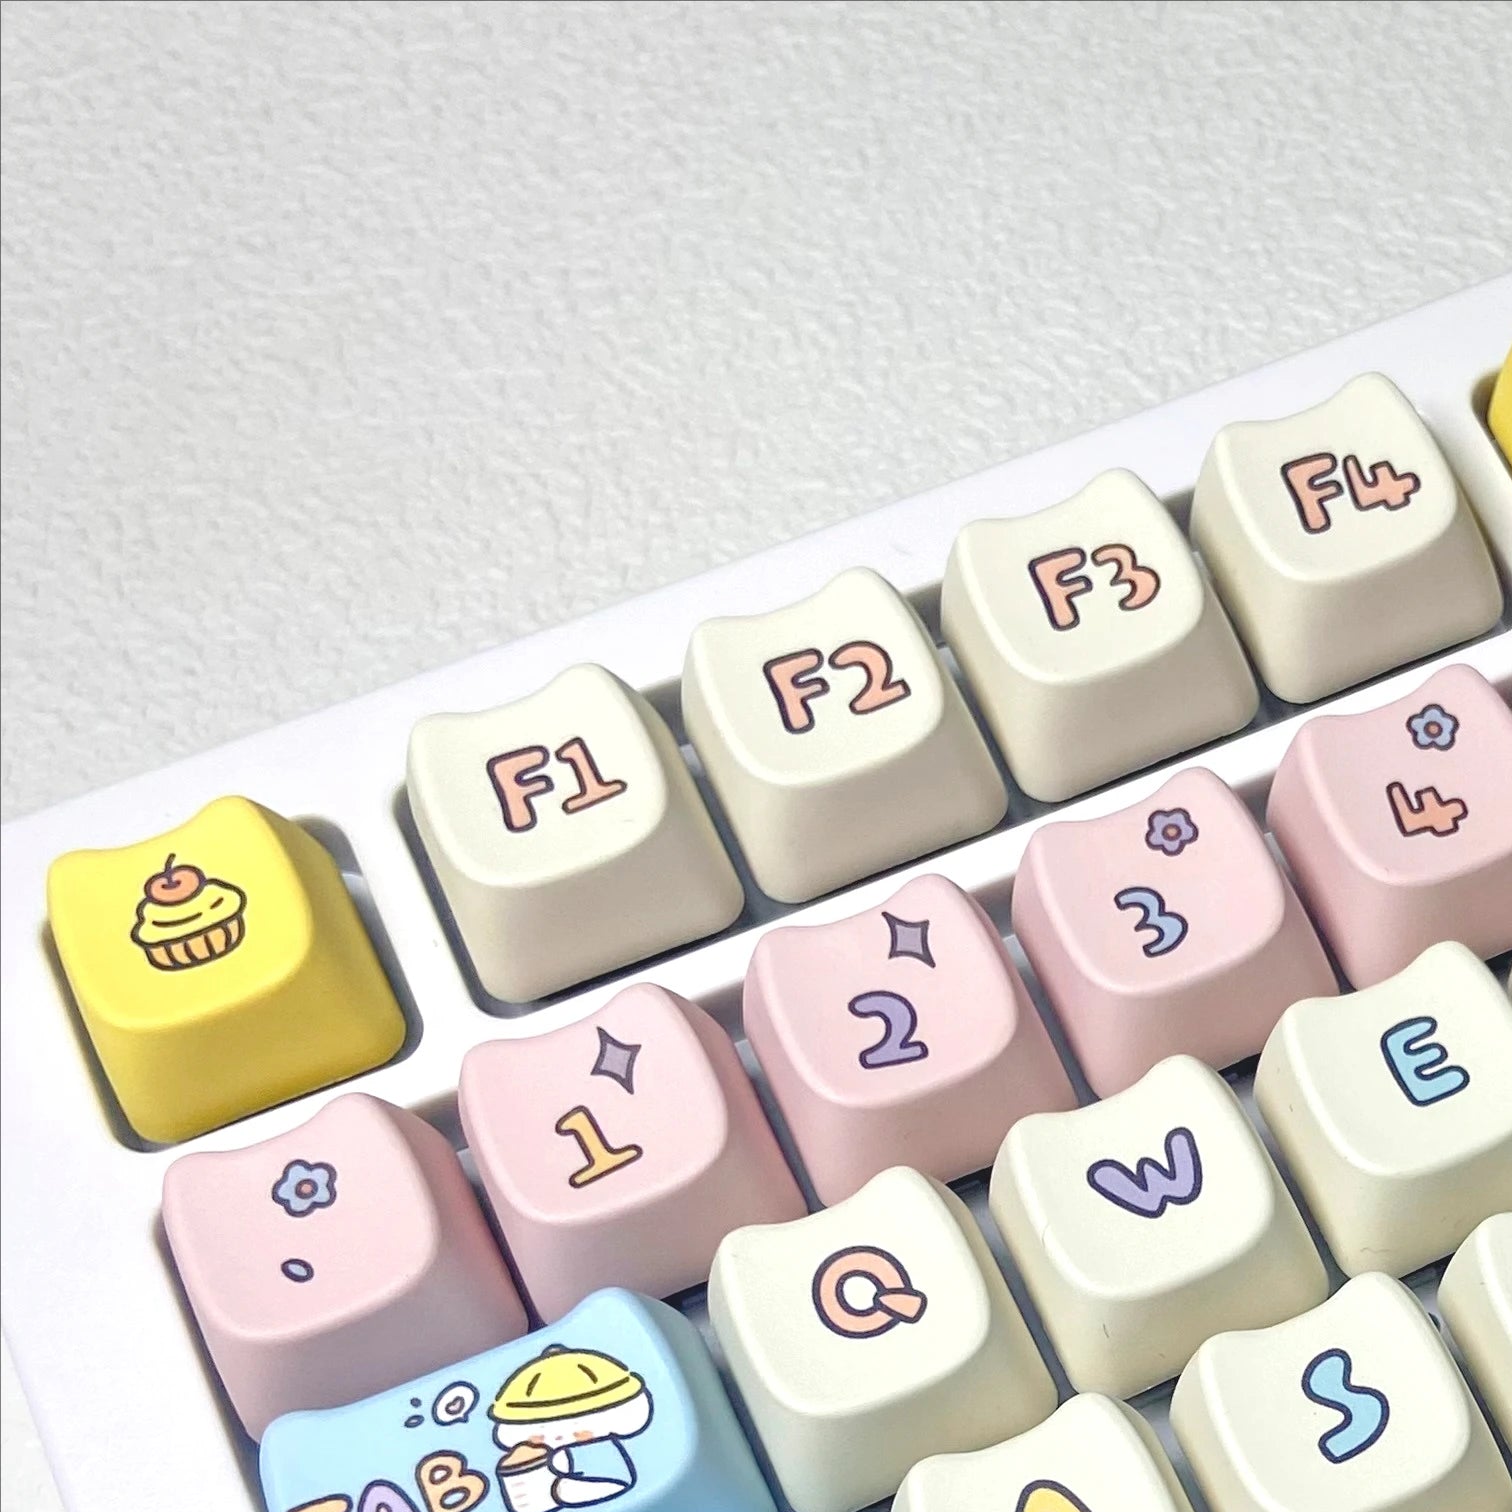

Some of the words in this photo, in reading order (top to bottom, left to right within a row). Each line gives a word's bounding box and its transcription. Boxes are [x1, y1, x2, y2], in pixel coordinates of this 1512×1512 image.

[1280, 451, 1422, 535] F4
[1027, 543, 1161, 632] F3
[762, 640, 912, 735] F2
[485, 736, 628, 833] F1
[1385, 781, 1469, 838] 4
[1113, 886, 1189, 958] 3
[847, 990, 929, 1070] 2
[1379, 1015, 1471, 1107] E
[554, 1105, 644, 1189] 1
[1086, 1126, 1203, 1219] W
[811, 1245, 928, 1340] Q
[1300, 1347, 1390, 1465] S
